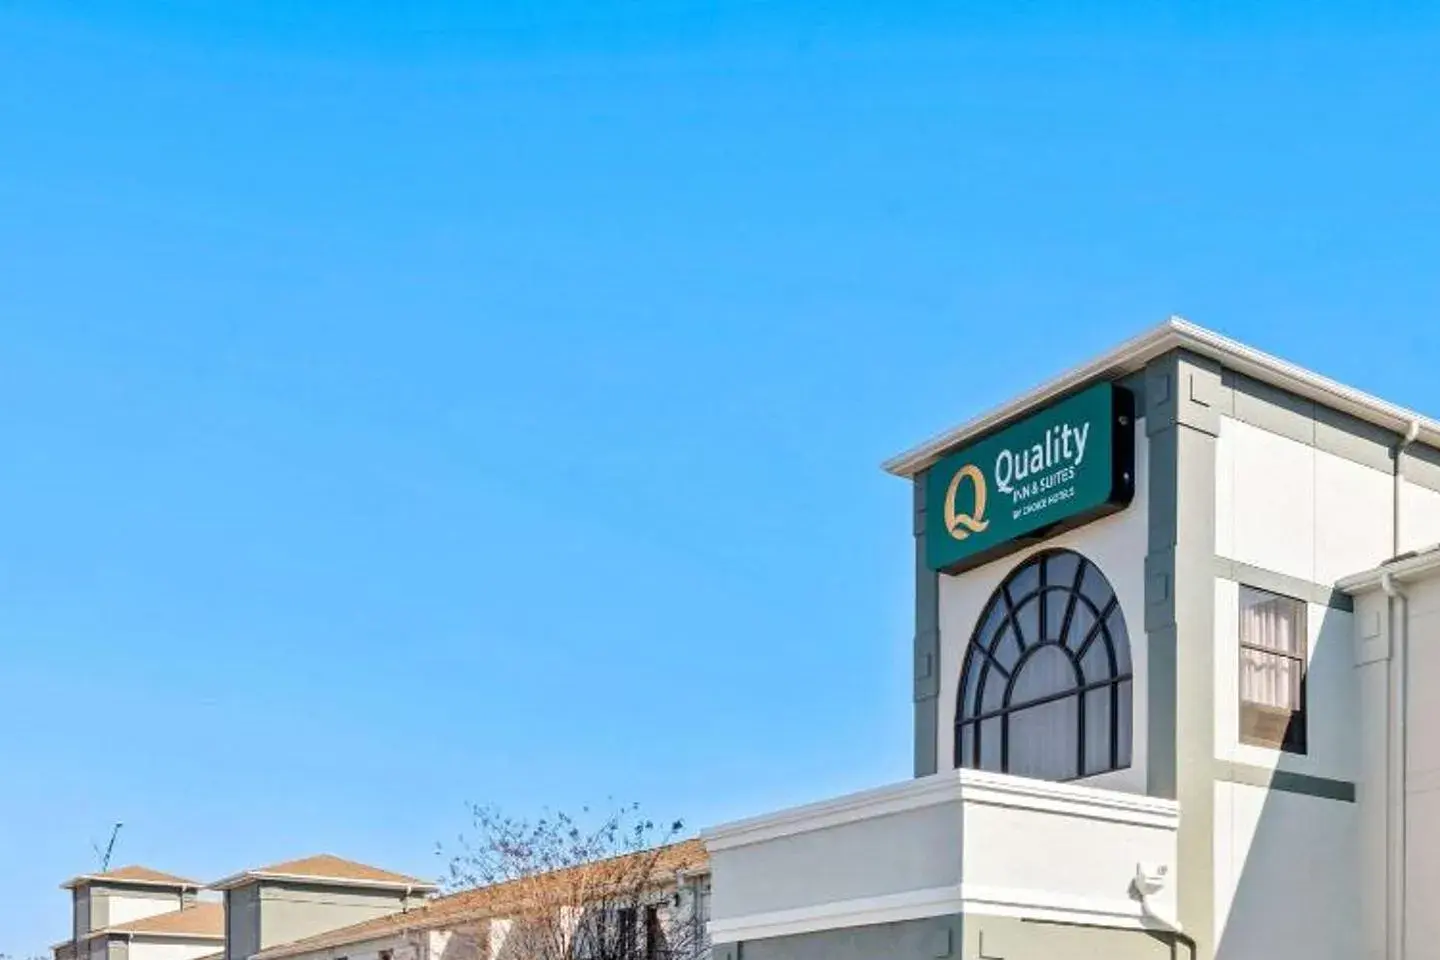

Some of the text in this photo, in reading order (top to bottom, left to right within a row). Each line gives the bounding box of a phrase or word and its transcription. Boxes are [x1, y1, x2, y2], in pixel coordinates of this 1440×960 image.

[994, 421, 1090, 493] Quality
[1012, 466, 1075, 503] INN & SUITES
[944, 464, 990, 540] Q
